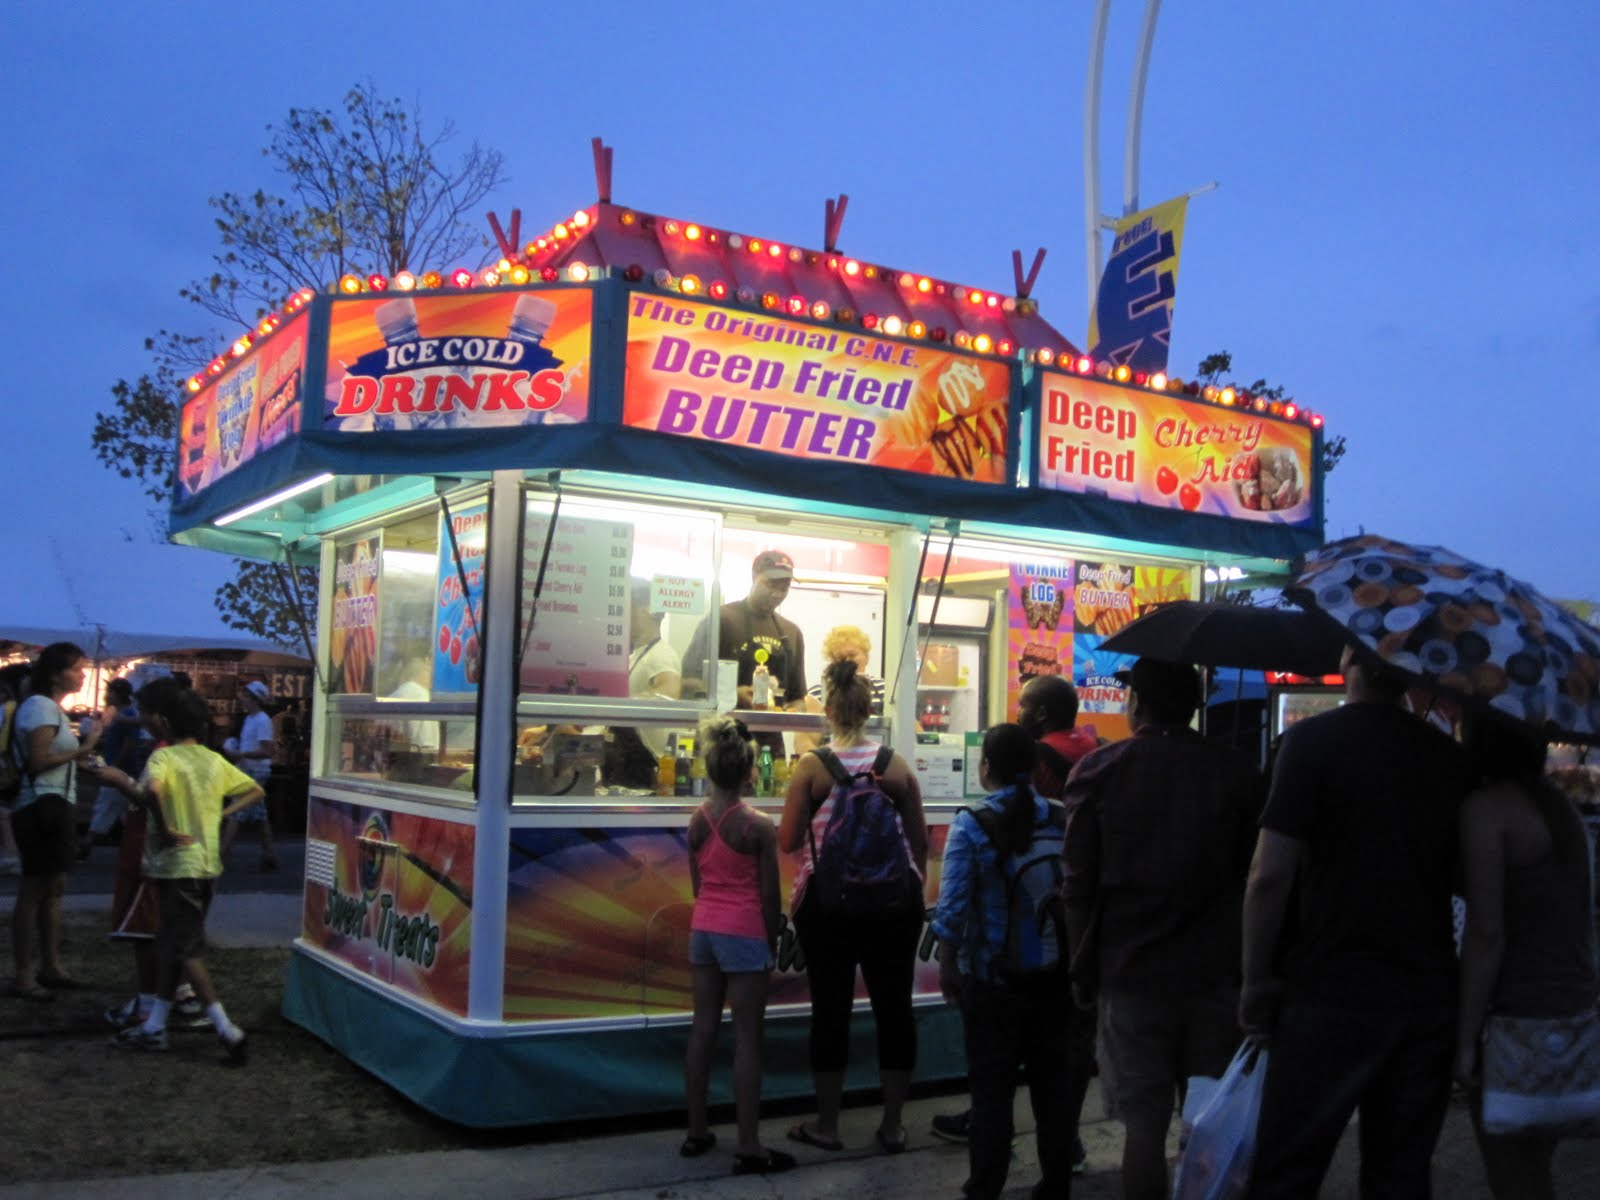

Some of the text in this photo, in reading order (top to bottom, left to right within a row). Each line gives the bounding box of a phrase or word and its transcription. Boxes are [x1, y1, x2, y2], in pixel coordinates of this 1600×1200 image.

[632, 296, 920, 369] The Original C.N.E.
[385, 337, 525, 370] ICE COLD
[652, 335, 914, 412] Deep Fried
[333, 369, 566, 417] DRINKS
[656, 388, 877, 461] BUTTER
[1048, 389, 1137, 441] Deep
[1154, 418, 1264, 452] Cherry
[1047, 435, 1135, 484] Fried
[1191, 450, 1260, 485] Aid
[1080, 564, 1132, 585] Deep Fried
[658, 588, 697, 600] ALLERGY
[1030, 583, 1055, 603] LOG
[1080, 589, 1130, 609] BUTTER
[1086, 676, 1101, 687] ICE
[376, 894, 440, 969] Treats
